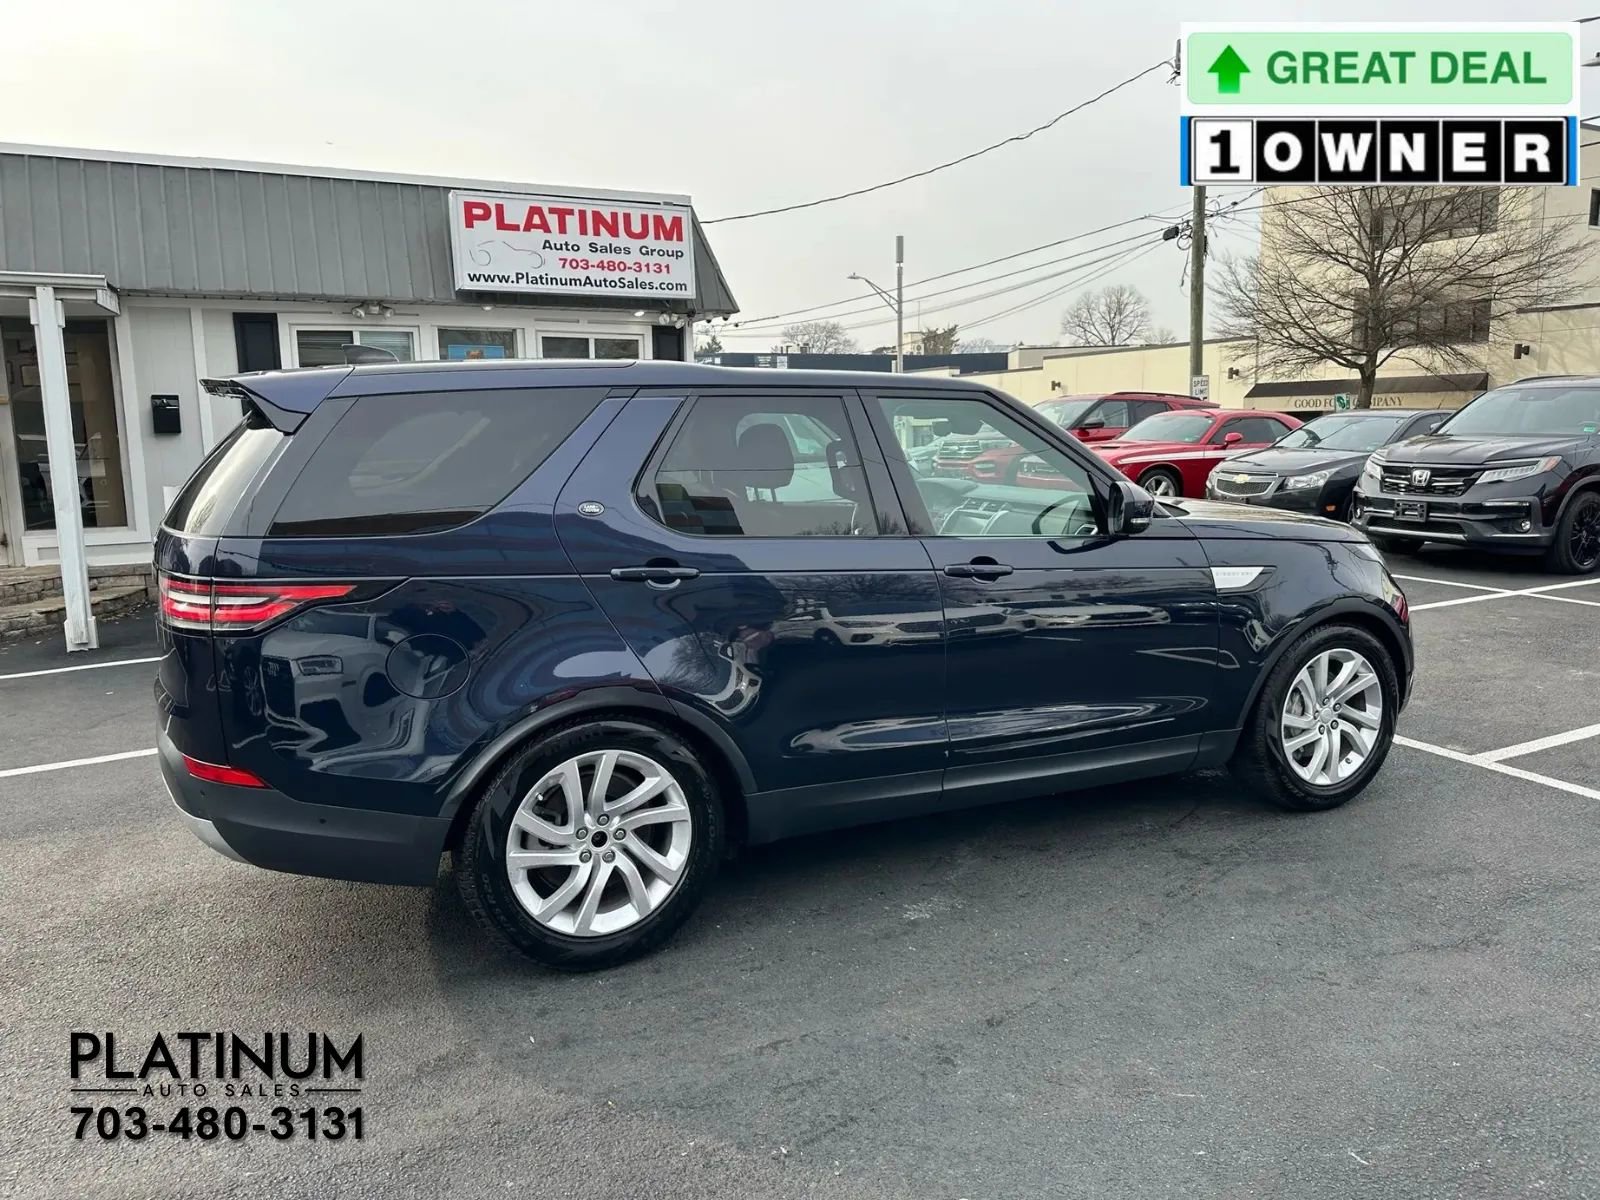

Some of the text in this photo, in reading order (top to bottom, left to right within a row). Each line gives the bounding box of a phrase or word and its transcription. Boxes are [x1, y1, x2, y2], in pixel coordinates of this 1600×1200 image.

[463, 200, 684, 242] PLATINUM
[542, 239, 684, 259] Auto Sales Group
[558, 257, 671, 275] 703-480-3131
[467, 271, 688, 292] www.PlatinumAutoSales.com
[1294, 398, 1321, 408] GOOD
